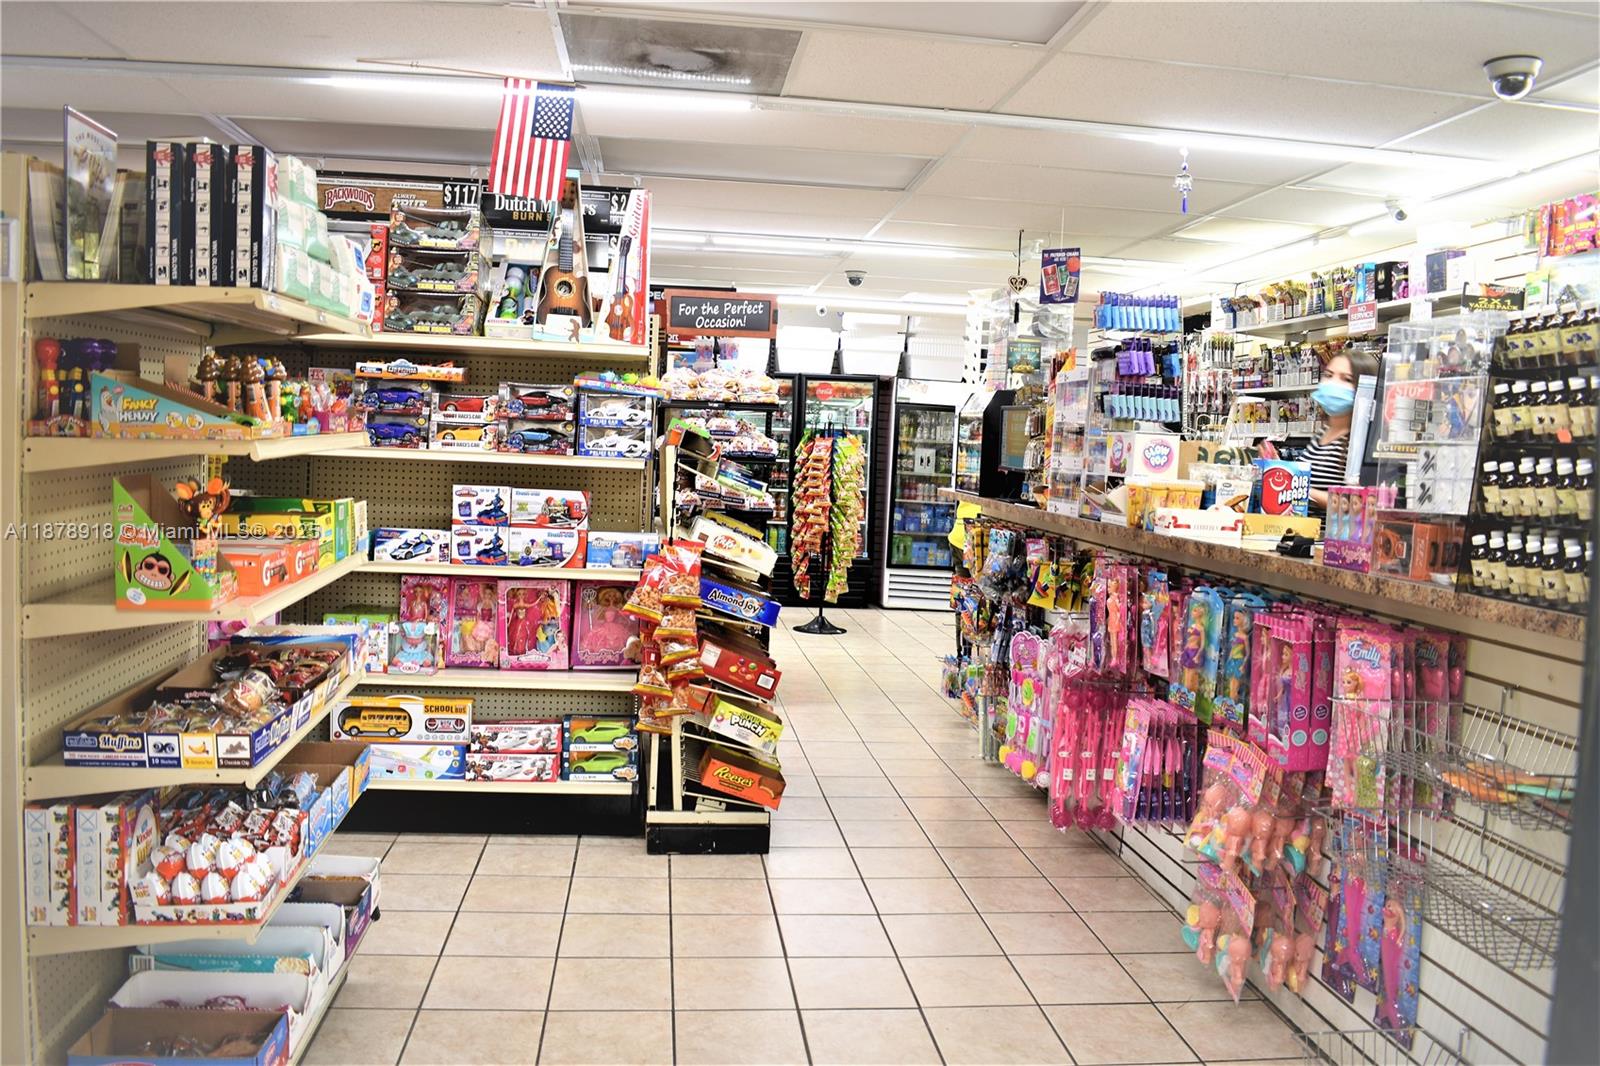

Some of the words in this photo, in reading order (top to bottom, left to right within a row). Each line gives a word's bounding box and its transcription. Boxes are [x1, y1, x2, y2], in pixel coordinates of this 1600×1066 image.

[325, 187, 374, 211] BACKWOODS
[494, 194, 537, 213] Dutch
[512, 212, 543, 221] BURN
[679, 303, 698, 316] For
[701, 302, 719, 315] the
[723, 301, 764, 315] Perfect
[1350, 310, 1375, 320] SERVICE
[695, 315, 747, 328] Occasion!
[1144, 443, 1172, 461] BLOW
[1150, 455, 1168, 467] POP
[1291, 475, 1309, 488] AIR
[1278, 488, 1309, 505] HEADS
[708, 588, 745, 608] Almond
[743, 600, 760, 614] Joy
[1348, 640, 1382, 669] Emily
[424, 704, 455, 714] SCHOOL
[454, 706, 467, 714] BUS
[730, 714, 767, 738] PUNCH
[99, 733, 142, 753] Muffins
